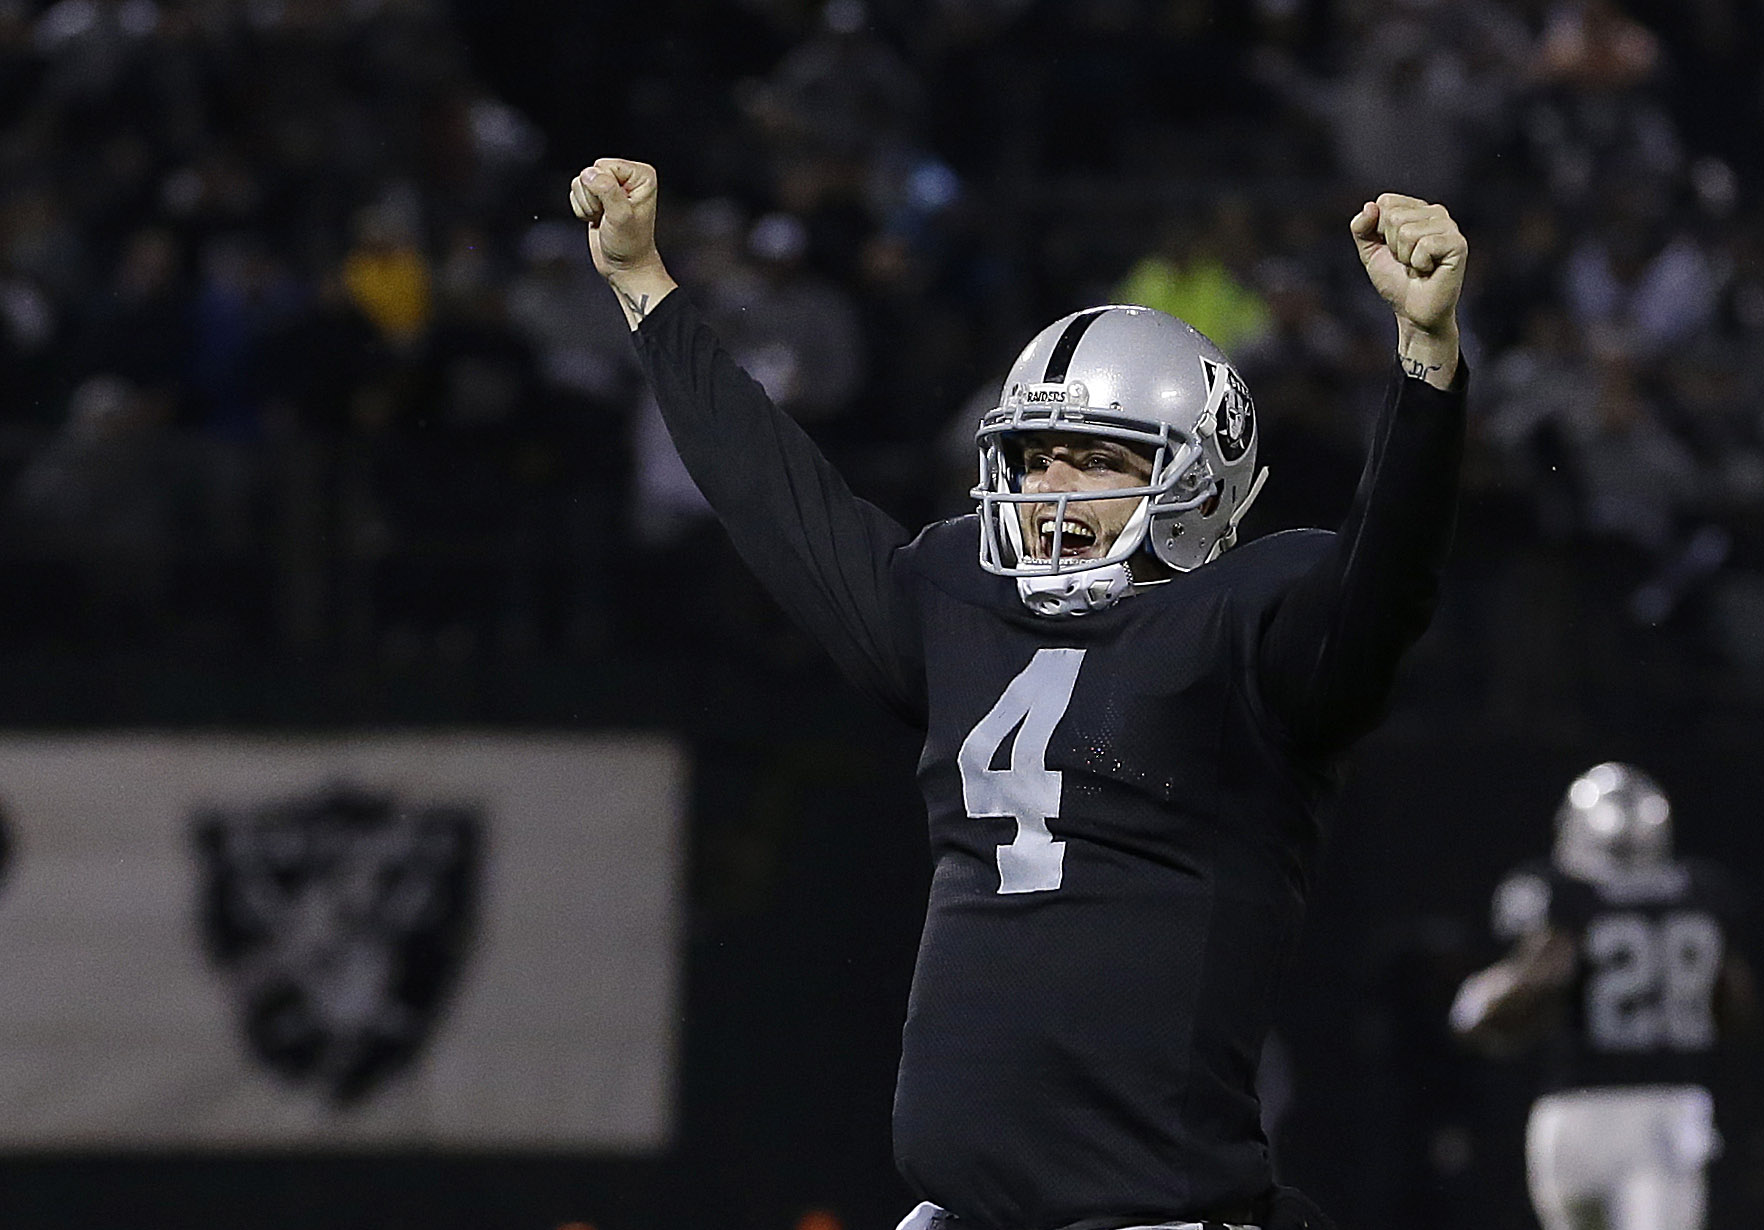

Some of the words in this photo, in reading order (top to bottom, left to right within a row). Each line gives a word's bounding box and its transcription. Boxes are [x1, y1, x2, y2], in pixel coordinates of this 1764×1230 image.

[1027, 391, 1066, 402] RAIDERS
[957, 648, 1087, 895] 4
[1584, 910, 1724, 1052] 28
